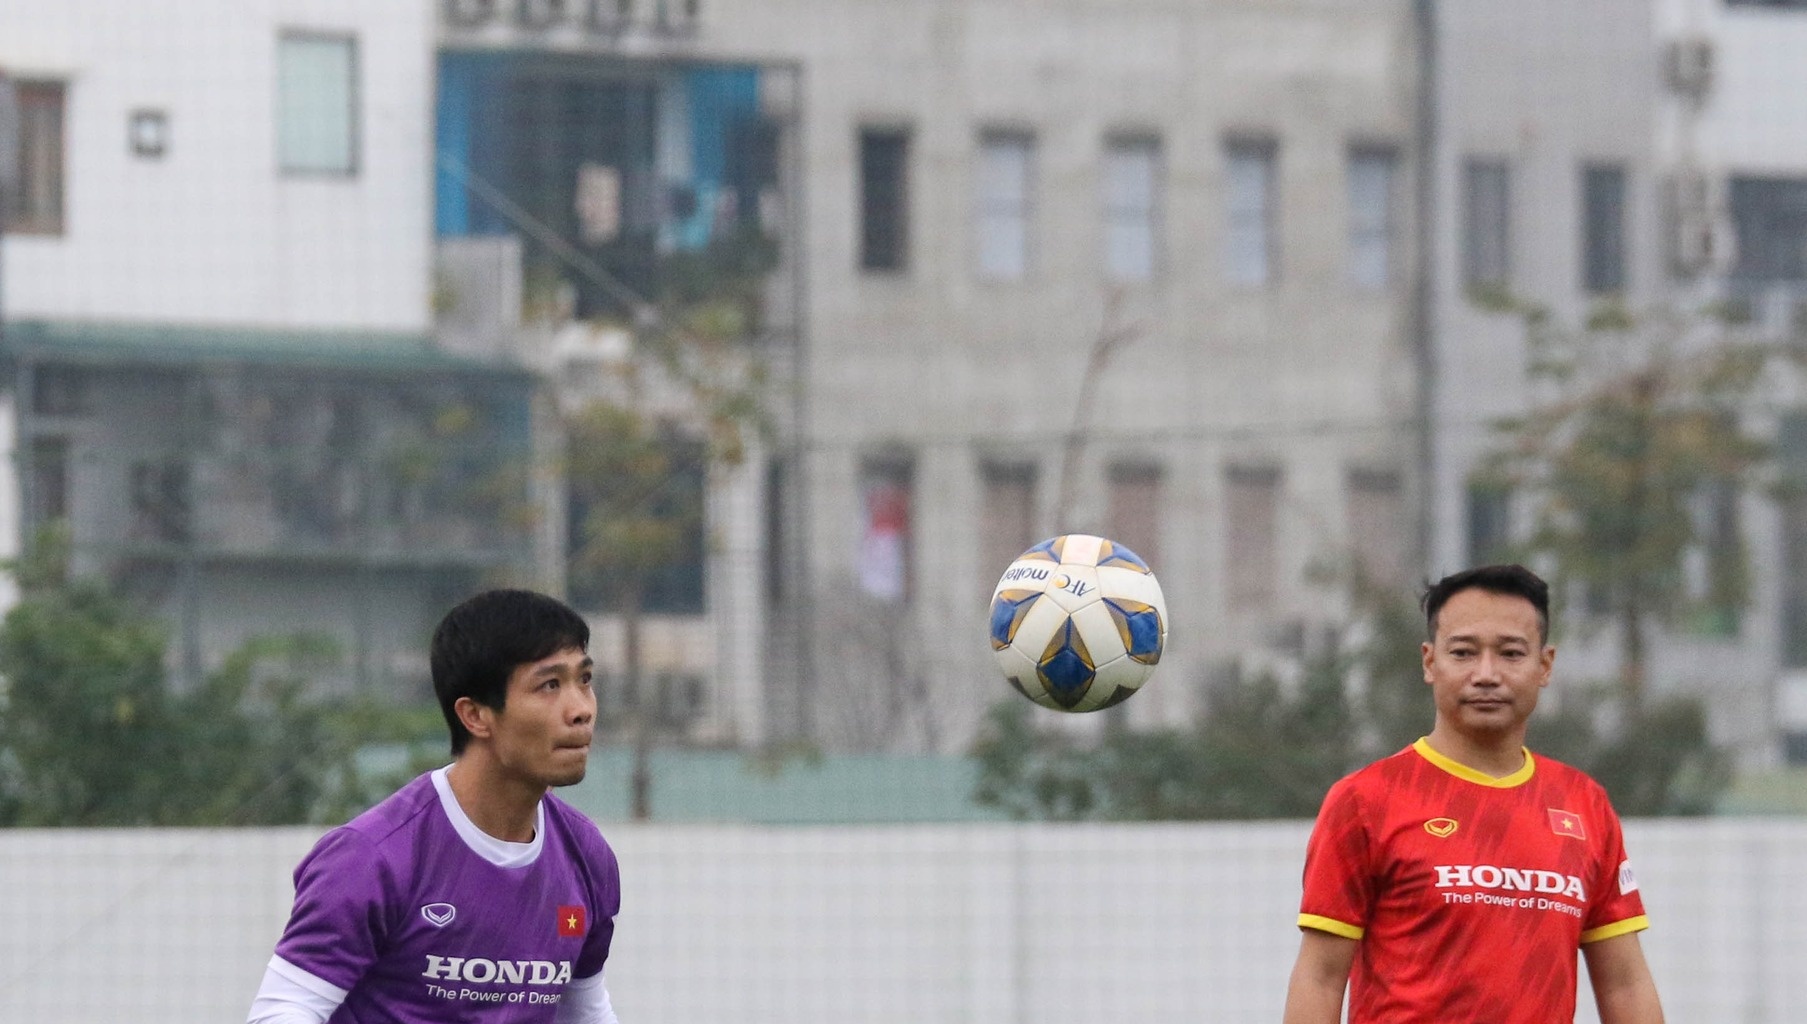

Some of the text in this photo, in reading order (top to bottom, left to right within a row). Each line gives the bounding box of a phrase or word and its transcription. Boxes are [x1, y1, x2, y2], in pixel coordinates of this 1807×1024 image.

[1434, 865, 1586, 902] HONDA
[1442, 892, 1582, 918] The Power of Dreams
[422, 954, 571, 985] HONDA
[425, 984, 457, 1000] The
[459, 988, 506, 1002] Power
[508, 991, 525, 1003] of
